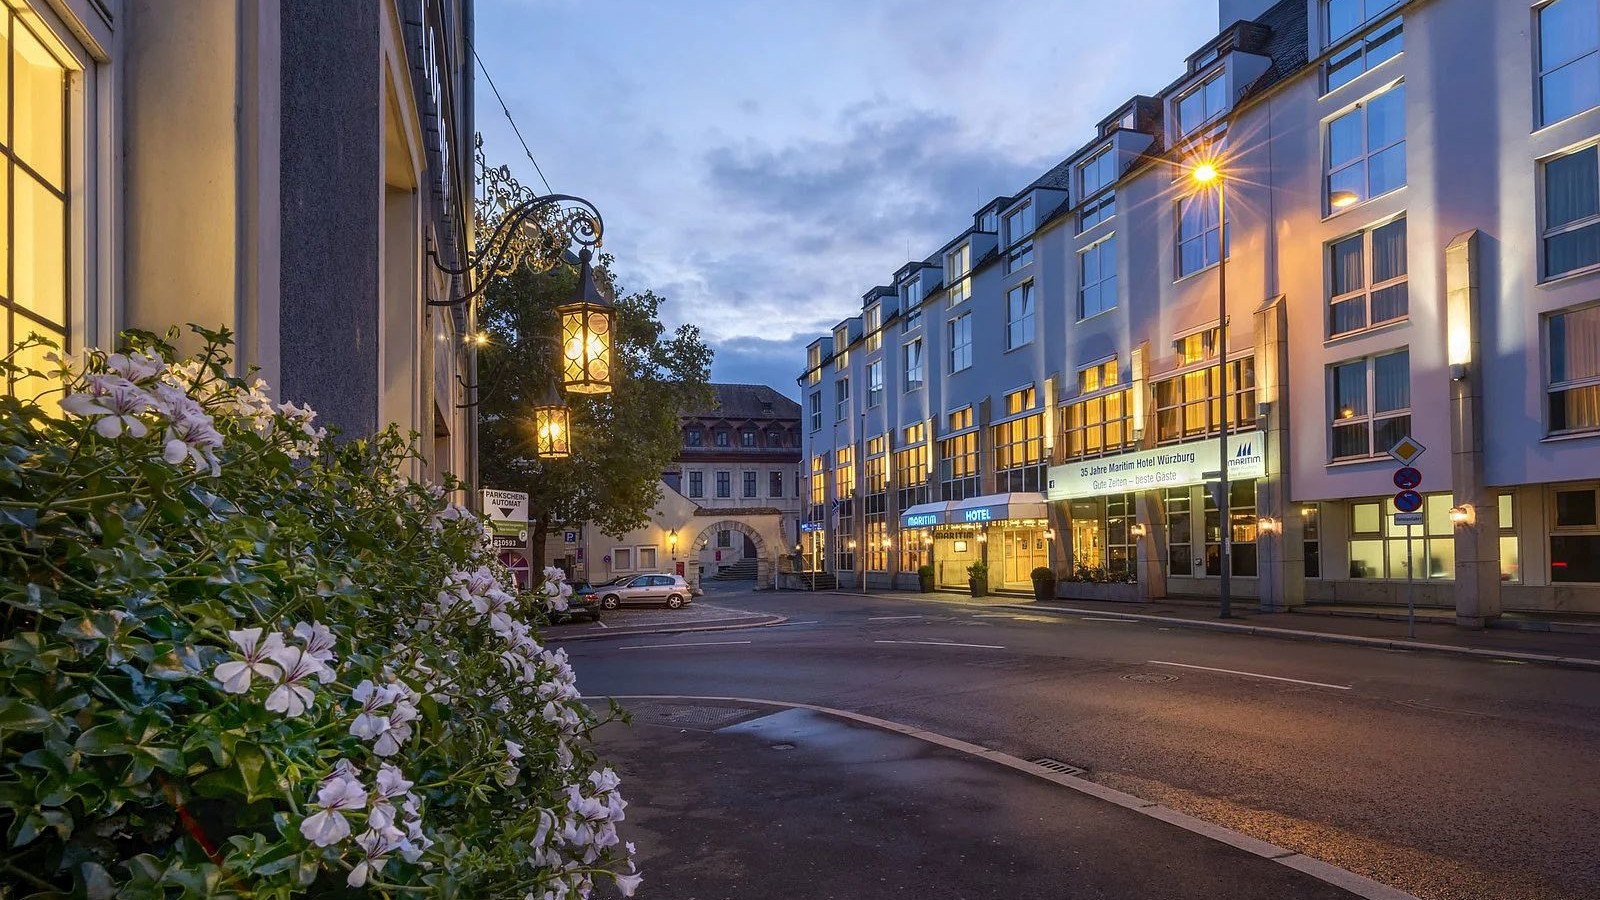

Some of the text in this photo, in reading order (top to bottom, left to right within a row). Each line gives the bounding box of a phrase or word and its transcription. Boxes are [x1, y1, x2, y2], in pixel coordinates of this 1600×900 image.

[1081, 453, 1195, 477] 35 Jahre Maritim Hotel Würzburg
[1228, 456, 1260, 466] MARITIM
[1093, 480, 1107, 489] Gute
[1109, 478, 1127, 488] Zeiten
[1136, 474, 1153, 484] beste
[485, 490, 527, 500] PARKSCHEIN-
[492, 499, 521, 507] AUTOMAT
[966, 509, 991, 521] HOTEL
[908, 515, 936, 526] MARITIM
[936, 531, 974, 540] MARITIM
